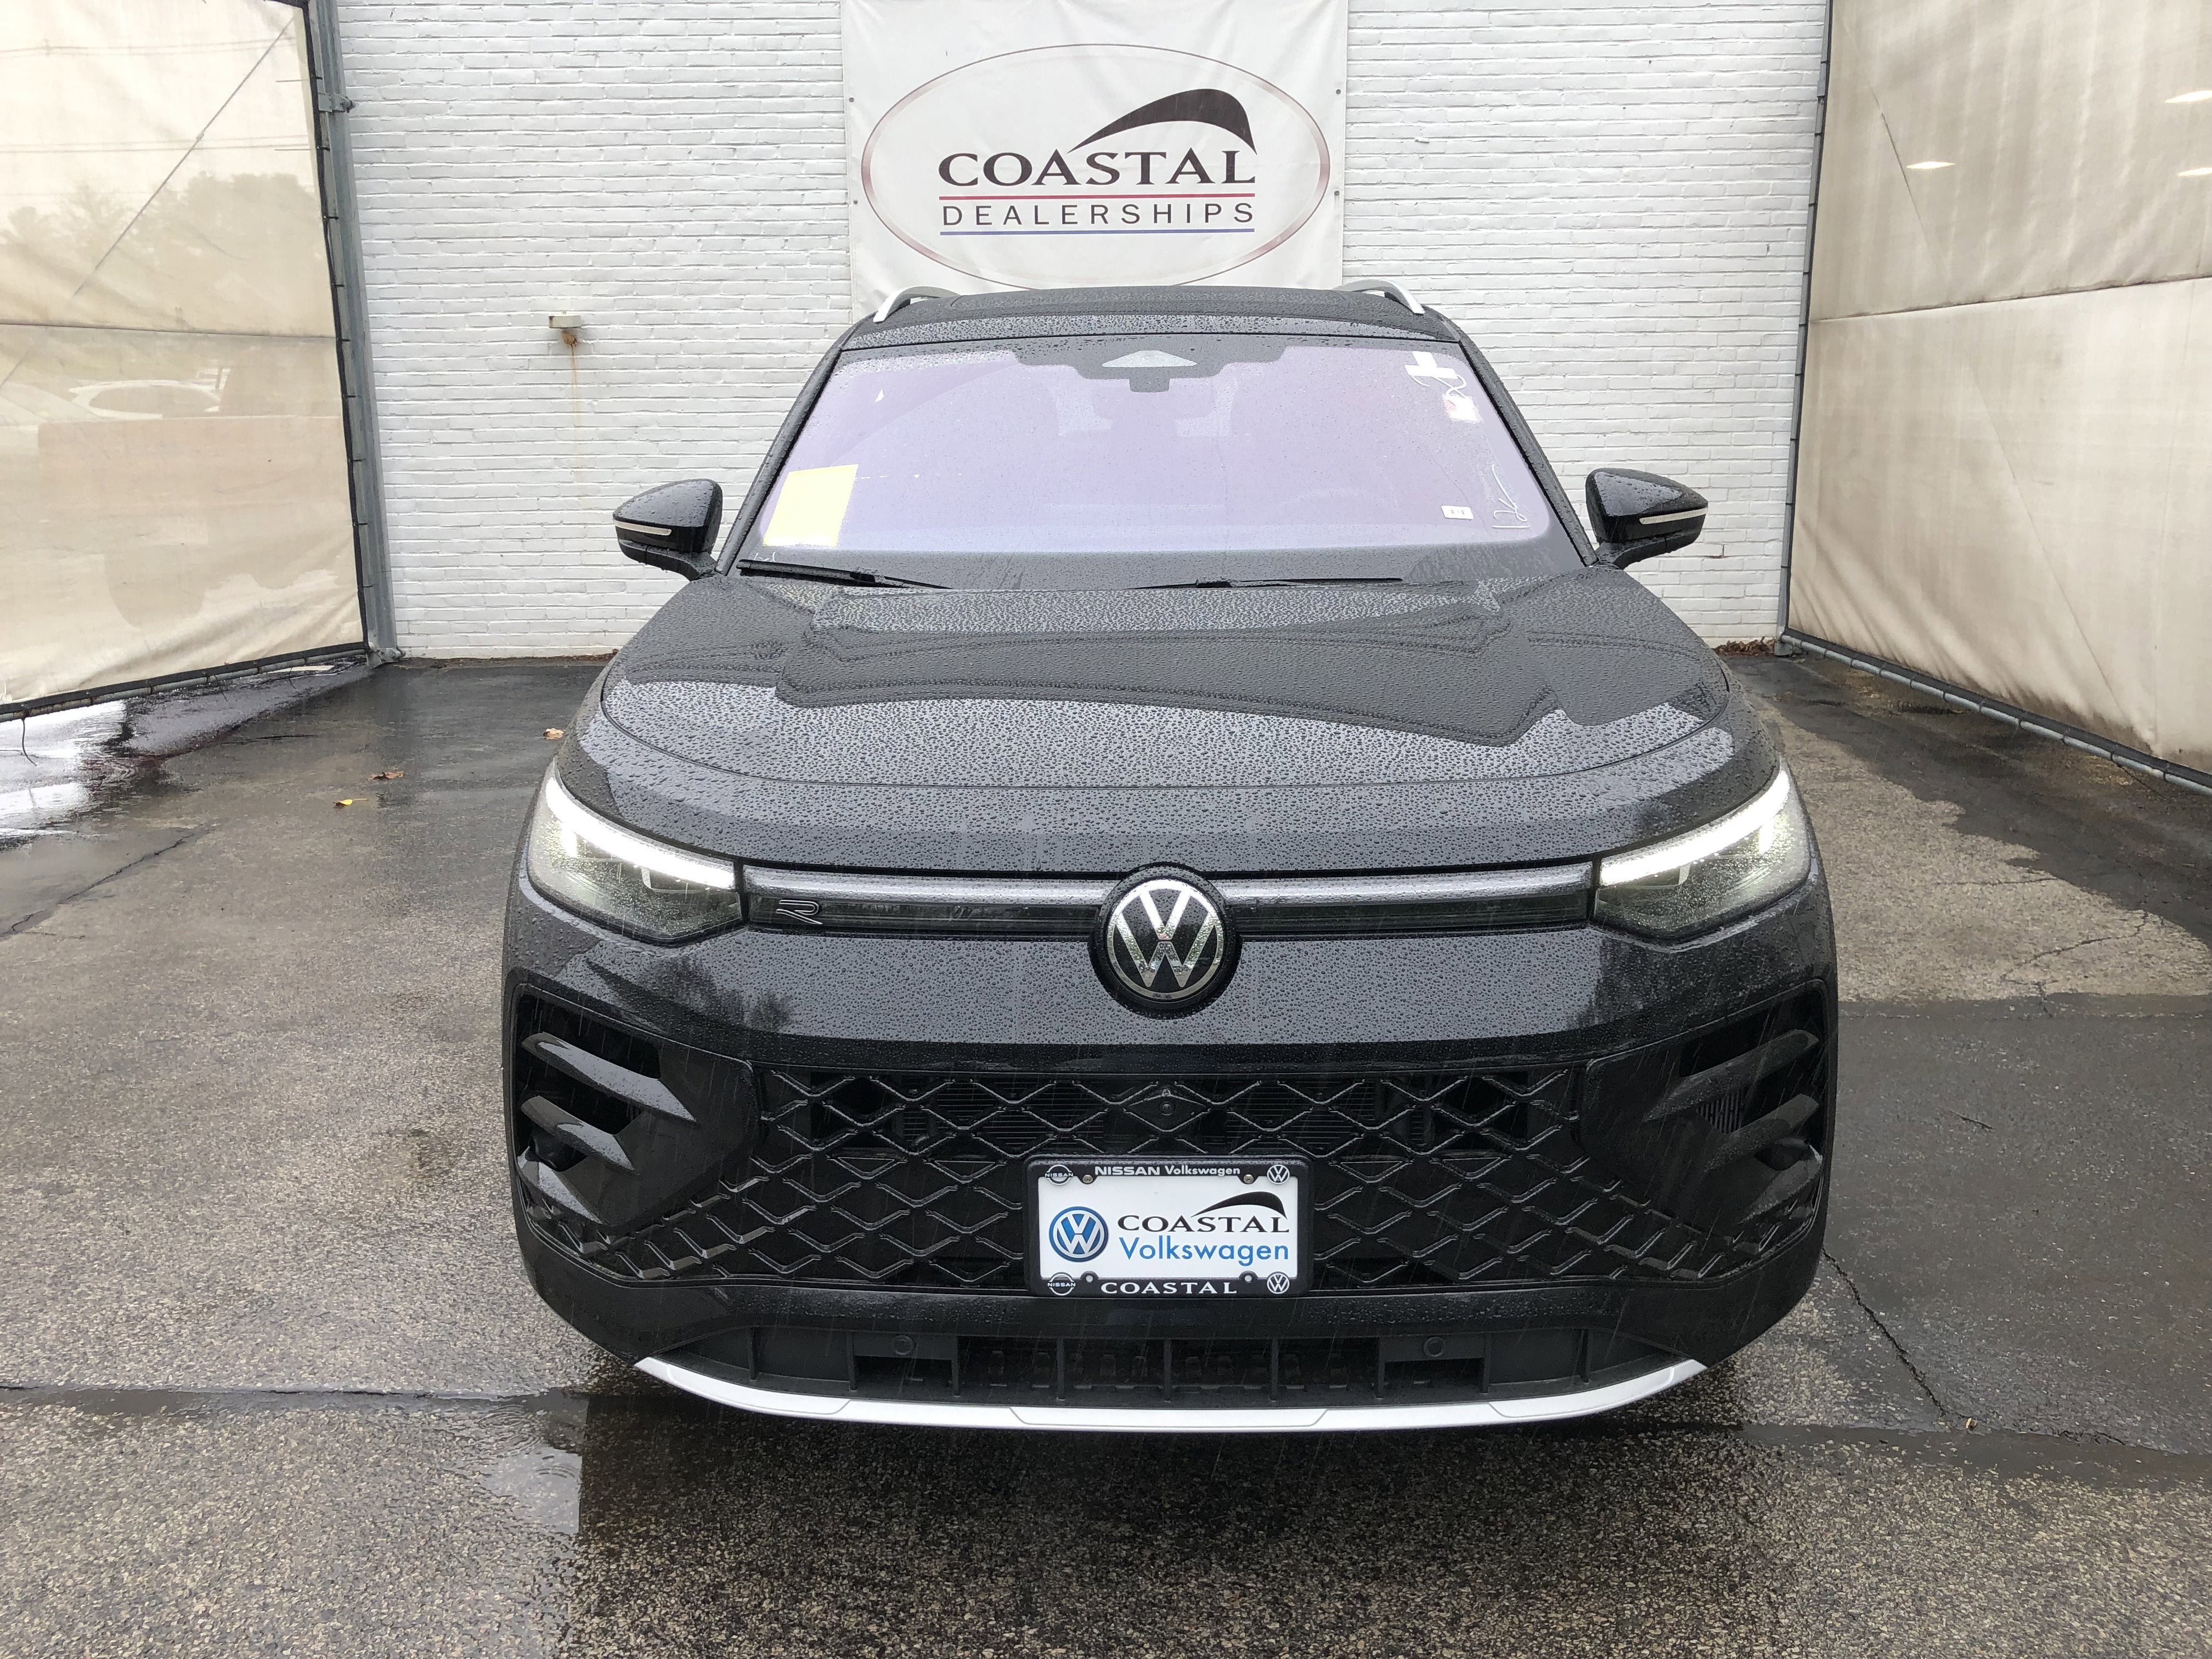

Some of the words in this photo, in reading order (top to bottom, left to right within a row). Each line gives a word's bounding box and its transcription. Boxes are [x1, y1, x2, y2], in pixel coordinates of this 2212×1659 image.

[939, 147, 1256, 187] COASTAL
[943, 202, 1254, 226] DEALERSHIPS
[1094, 1166, 1160, 1176] NISSAN
[1164, 1165, 1241, 1176] Volkswagen
[1118, 1215, 1290, 1233] COASTAL
[1119, 1235, 1289, 1266] Volkswagen
[1101, 1281, 1238, 1295] COASTAL
